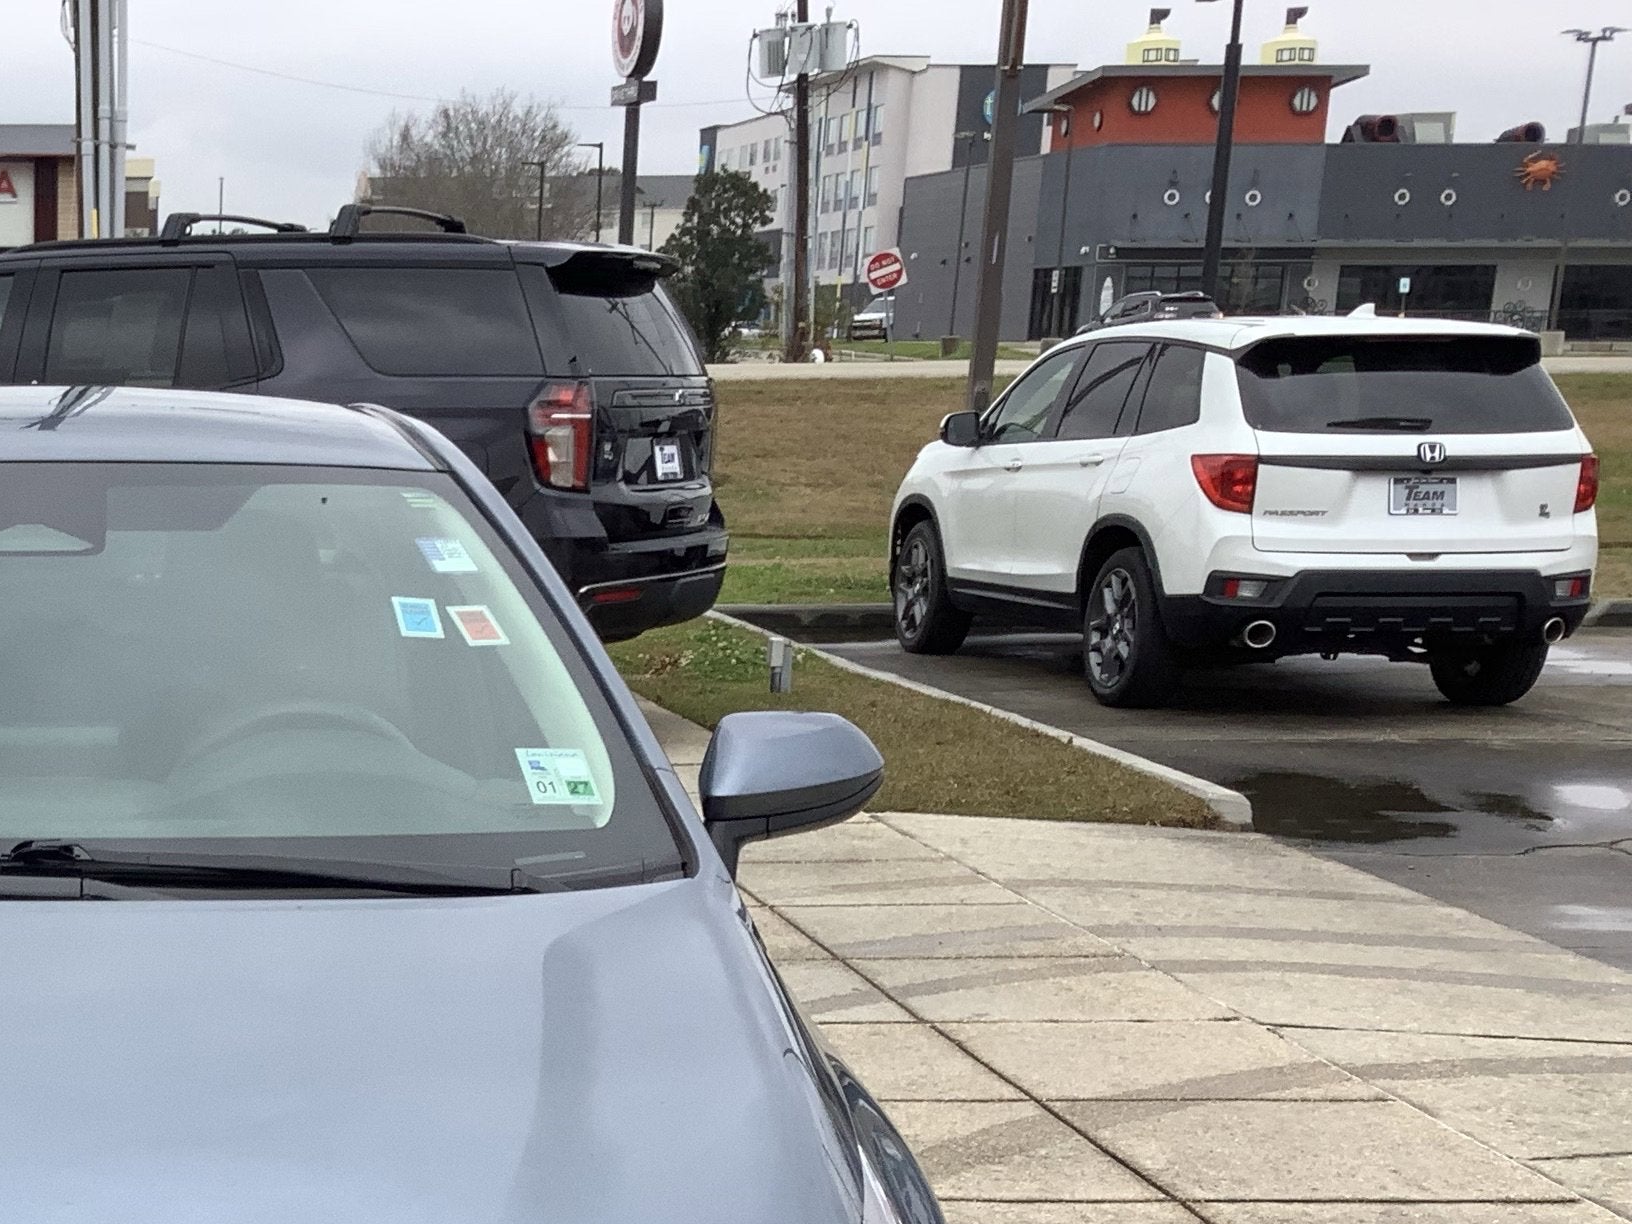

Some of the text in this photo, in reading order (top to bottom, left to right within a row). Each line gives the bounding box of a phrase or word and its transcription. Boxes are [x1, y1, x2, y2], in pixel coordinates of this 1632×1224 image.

[1405, 485, 1445, 501] TEAM
[1262, 509, 1329, 517] PASSPORT
[536, 780, 590, 795] 01 27
